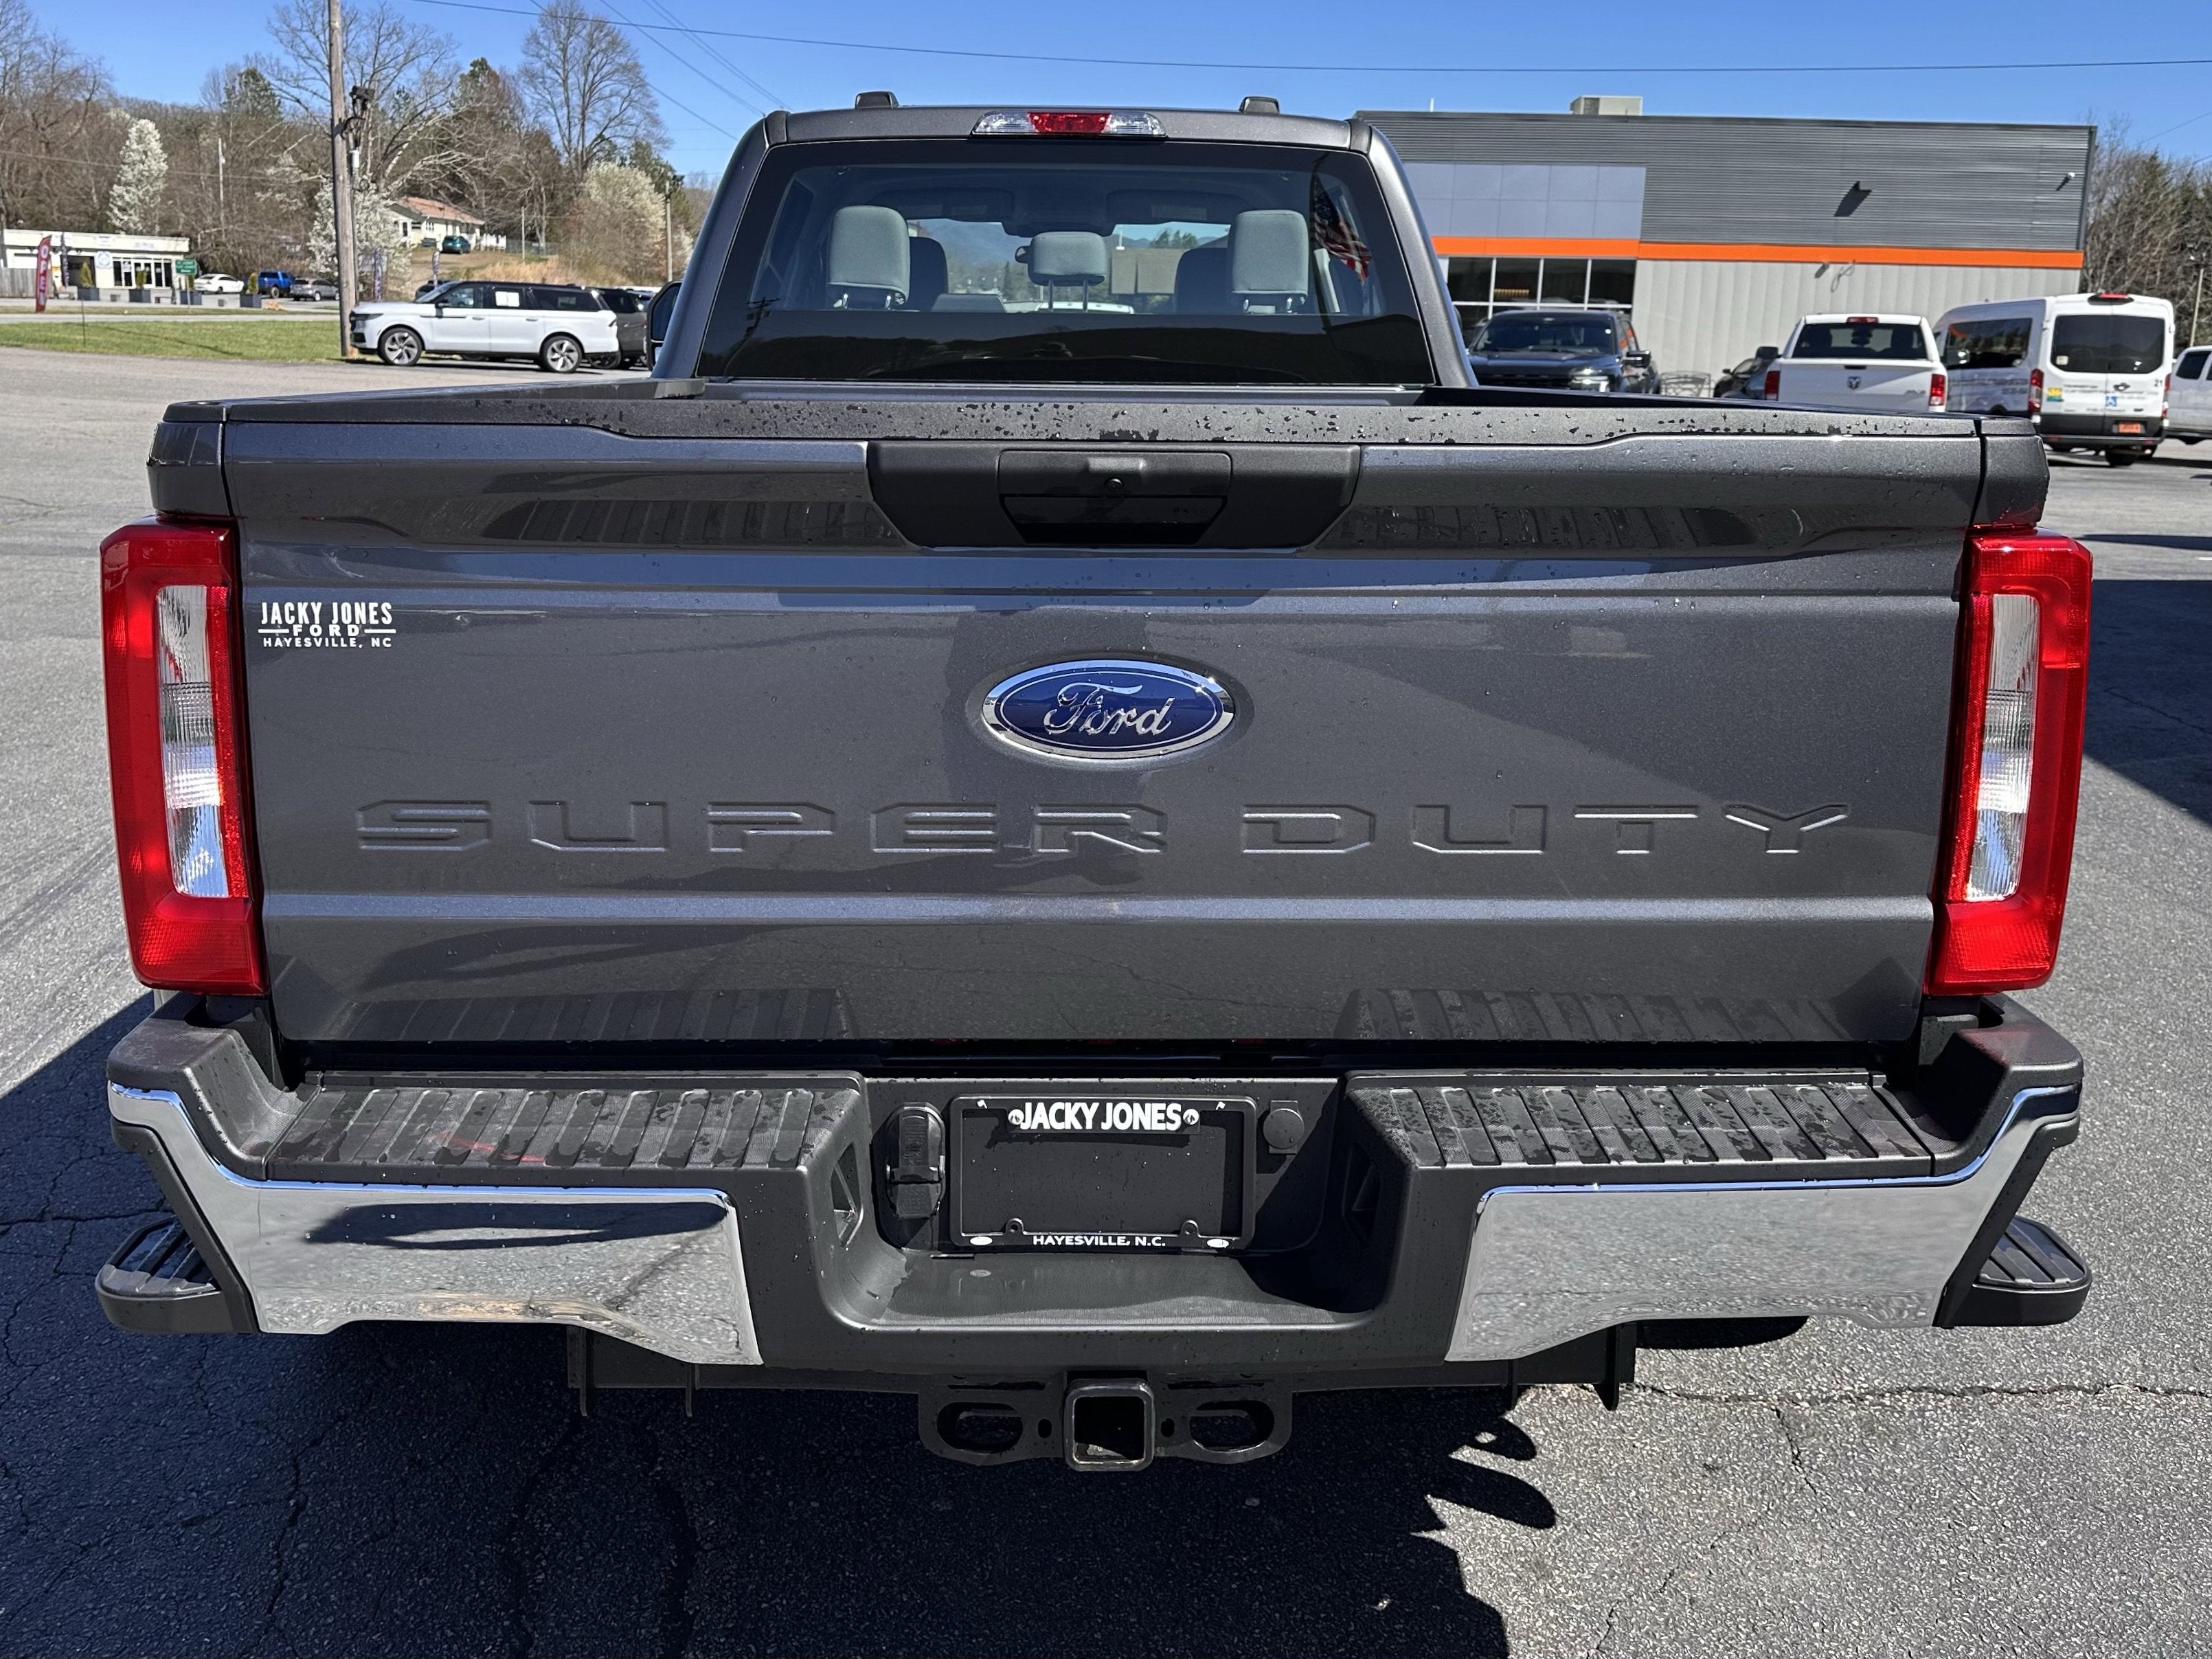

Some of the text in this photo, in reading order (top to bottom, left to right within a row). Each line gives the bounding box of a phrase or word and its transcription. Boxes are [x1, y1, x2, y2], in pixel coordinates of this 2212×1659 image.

[261, 602, 393, 624] JACKY JONES
[293, 624, 359, 637] FORD
[263, 637, 392, 648] HAYESVILLE, NC
[1043, 682, 1176, 735] Ford
[355, 800, 1851, 855] SUPER DUTY
[1020, 1102, 1182, 1131] JACKY JONES
[1032, 1235, 1166, 1247] HAYESVILLE, N.C.
